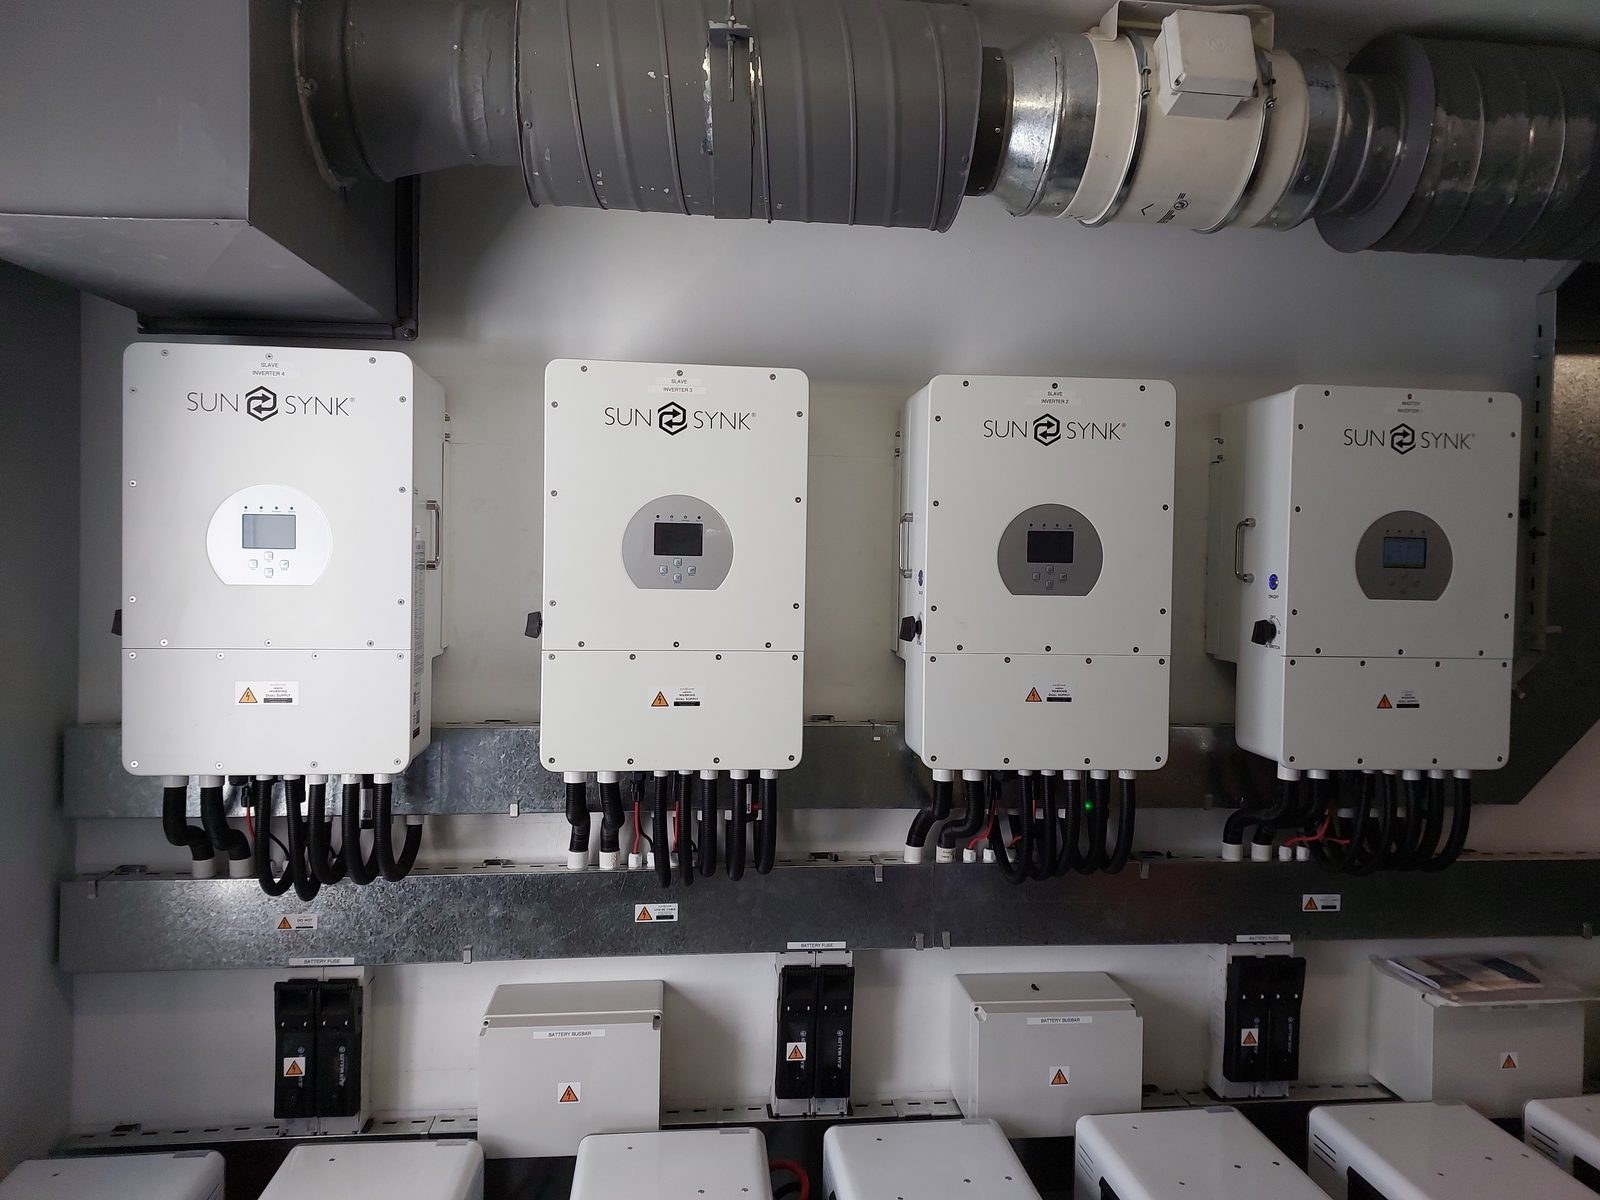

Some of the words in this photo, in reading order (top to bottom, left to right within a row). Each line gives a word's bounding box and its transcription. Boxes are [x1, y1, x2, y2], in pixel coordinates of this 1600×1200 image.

[186, 391, 239, 412] SUN
[604, 406, 652, 427] SUN
[983, 419, 1028, 438] SUN
[1343, 428, 1385, 447] SUN
